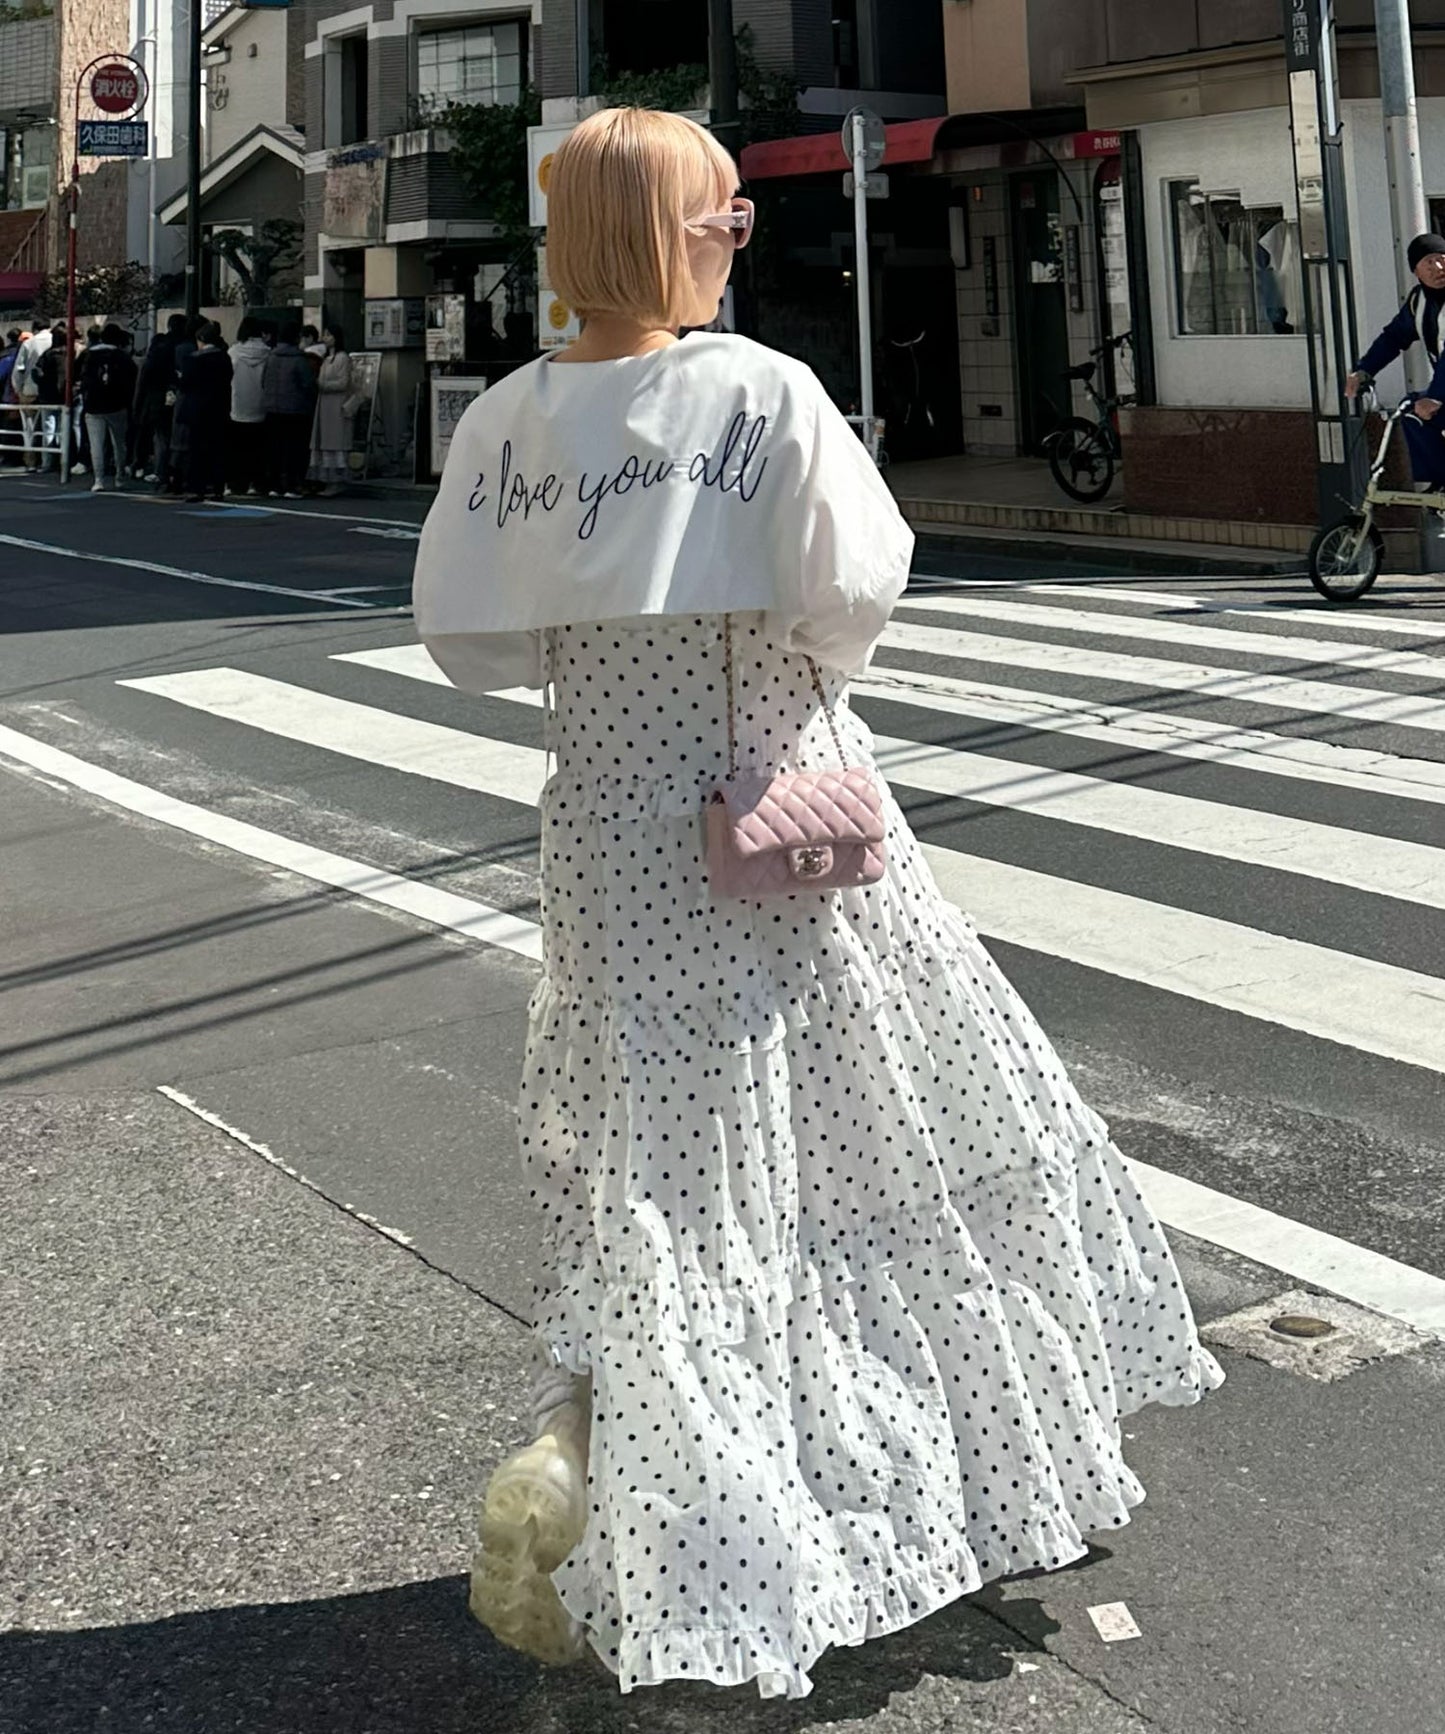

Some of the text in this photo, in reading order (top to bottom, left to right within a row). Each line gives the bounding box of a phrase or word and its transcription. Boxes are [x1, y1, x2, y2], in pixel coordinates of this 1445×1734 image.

[95, 79, 135, 99] 消火栓
[82, 124, 145, 145] 久保田歯科
[497, 439, 563, 528] love
[578, 455, 674, 539] you
[689, 411, 768, 502] all
